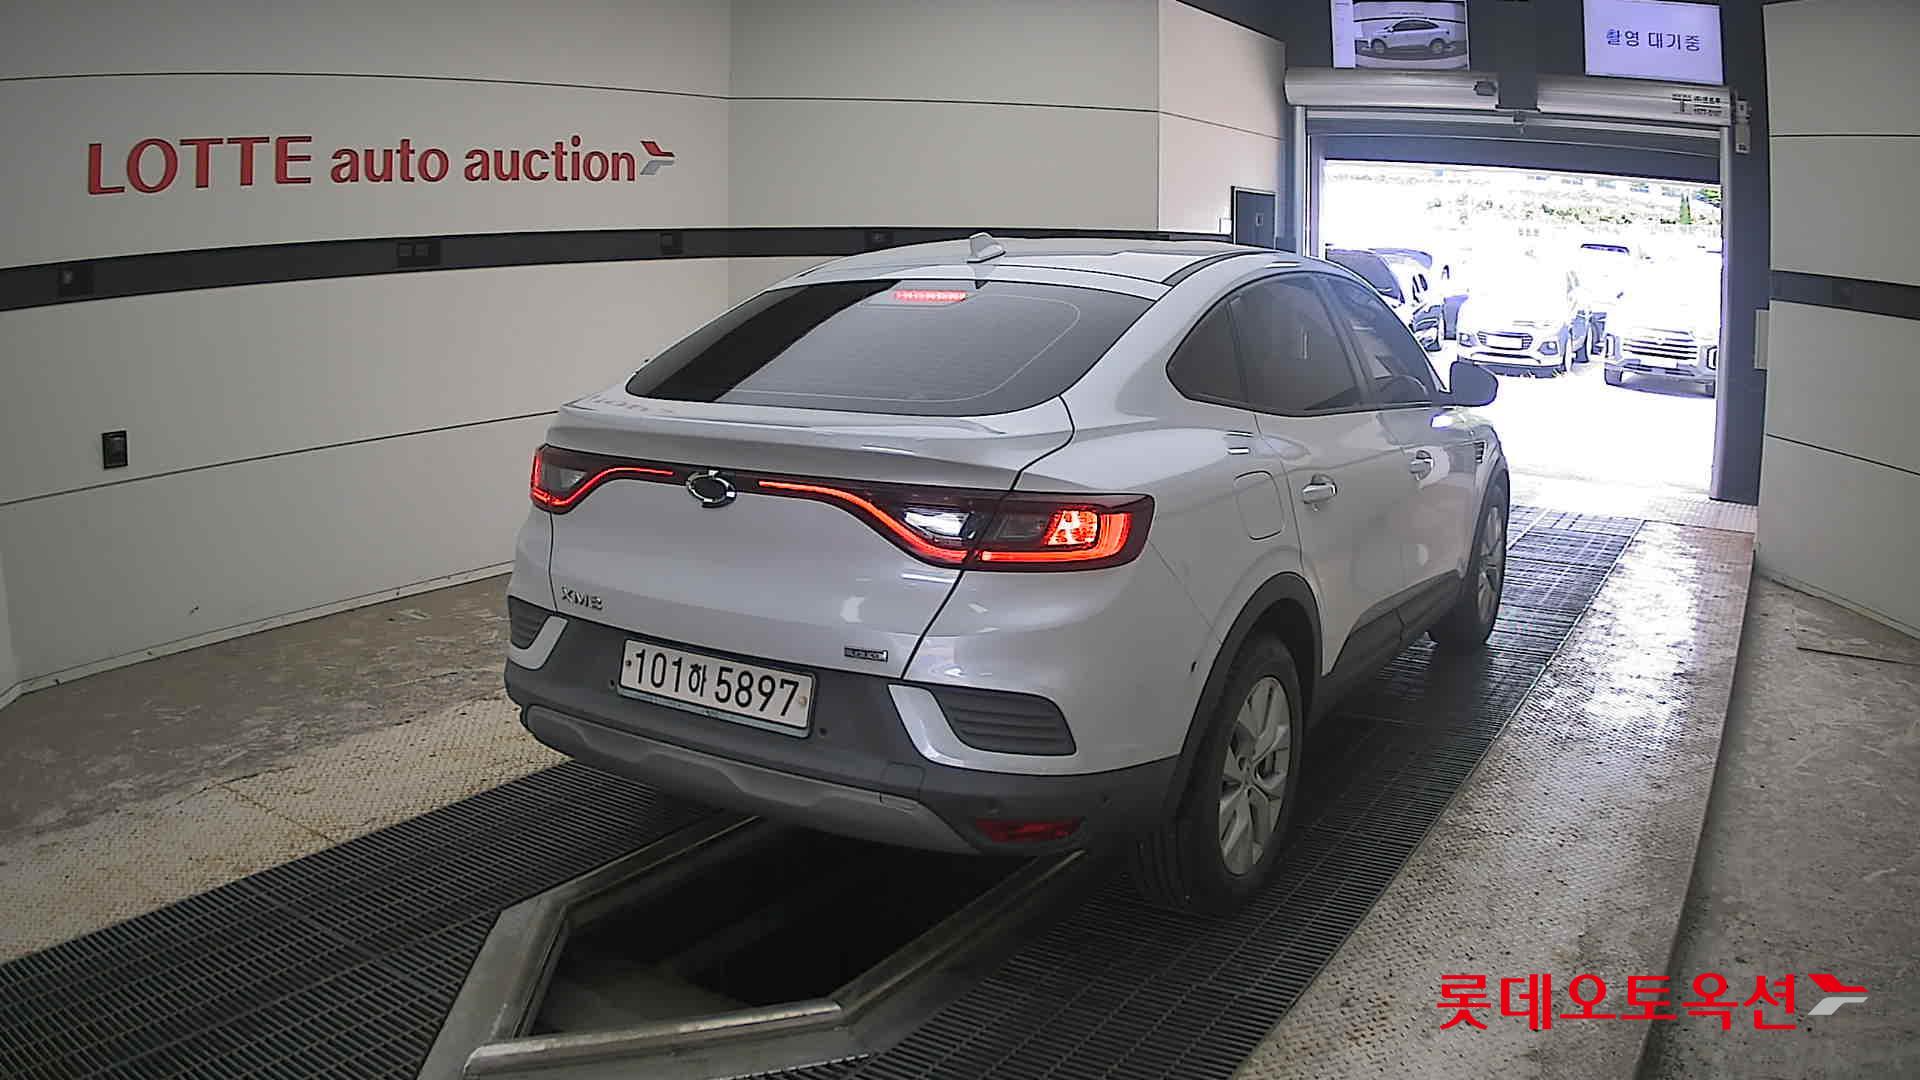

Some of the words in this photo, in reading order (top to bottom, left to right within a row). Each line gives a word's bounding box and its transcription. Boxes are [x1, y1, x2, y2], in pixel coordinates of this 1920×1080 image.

[1648, 32, 1701, 52] 대기중
[88, 136, 312, 194] LOTTE
[330, 138, 449, 184] auto
[464, 135, 636, 182] auction
